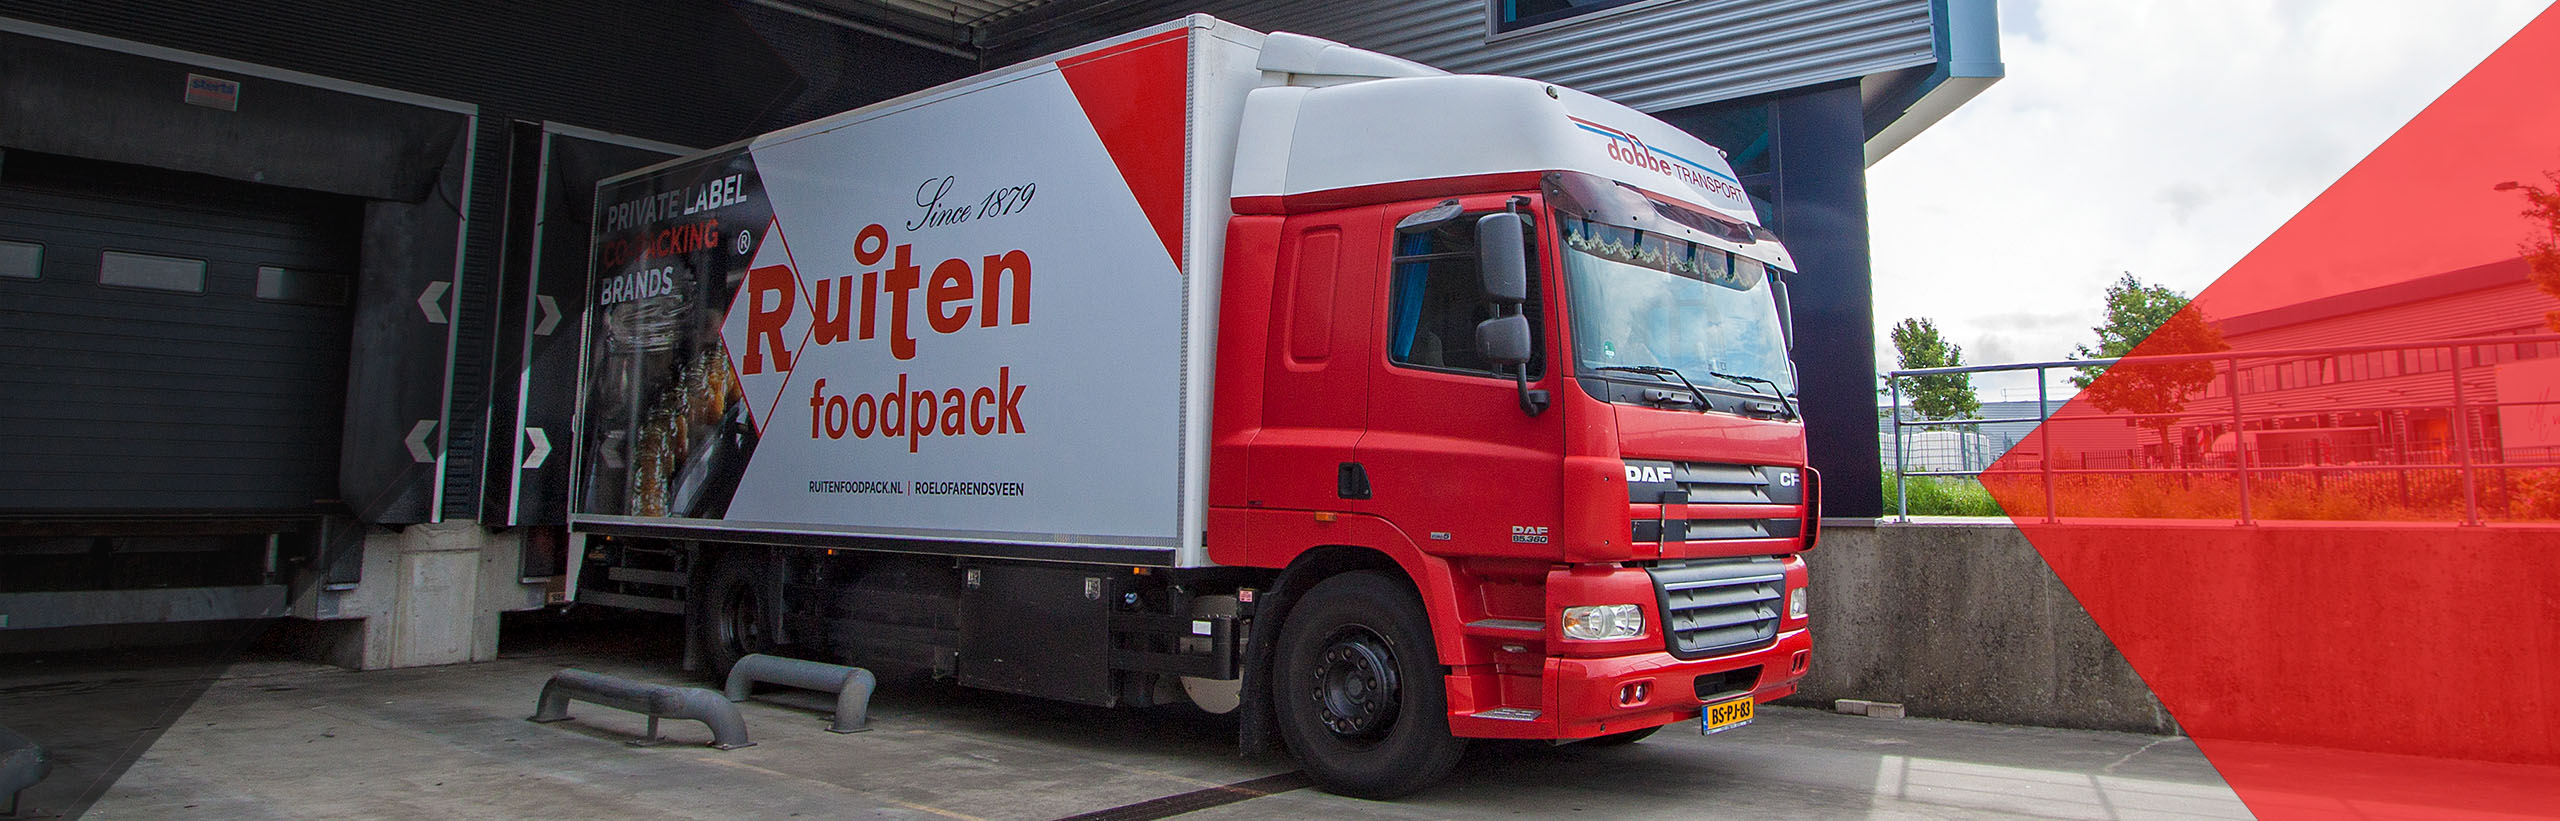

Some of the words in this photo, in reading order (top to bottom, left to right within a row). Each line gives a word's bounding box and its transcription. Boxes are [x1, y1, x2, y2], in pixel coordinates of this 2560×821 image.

[1607, 137, 1672, 176] dobbe
[1673, 163, 1744, 204] TRANSPORT
[607, 189, 680, 232] PRIVATE
[674, 174, 747, 215] LABEL
[906, 175, 972, 232] Since
[976, 182, 1036, 220] 1879
[603, 218, 719, 270] CO-PACKING
[601, 266, 674, 305] BRANDS
[742, 223, 1032, 376] Ruiten
[809, 365, 1028, 454] foodpack
[808, 480, 903, 495] RUITENFOODPACK.NL
[915, 481, 1025, 497] ROELOFARENDSVEEN
[1624, 465, 1673, 484] DAF
[1779, 471, 1801, 487] CF
[1512, 525, 1549, 535] DAF
[1712, 701, 1750, 725] BS-PJ-83
